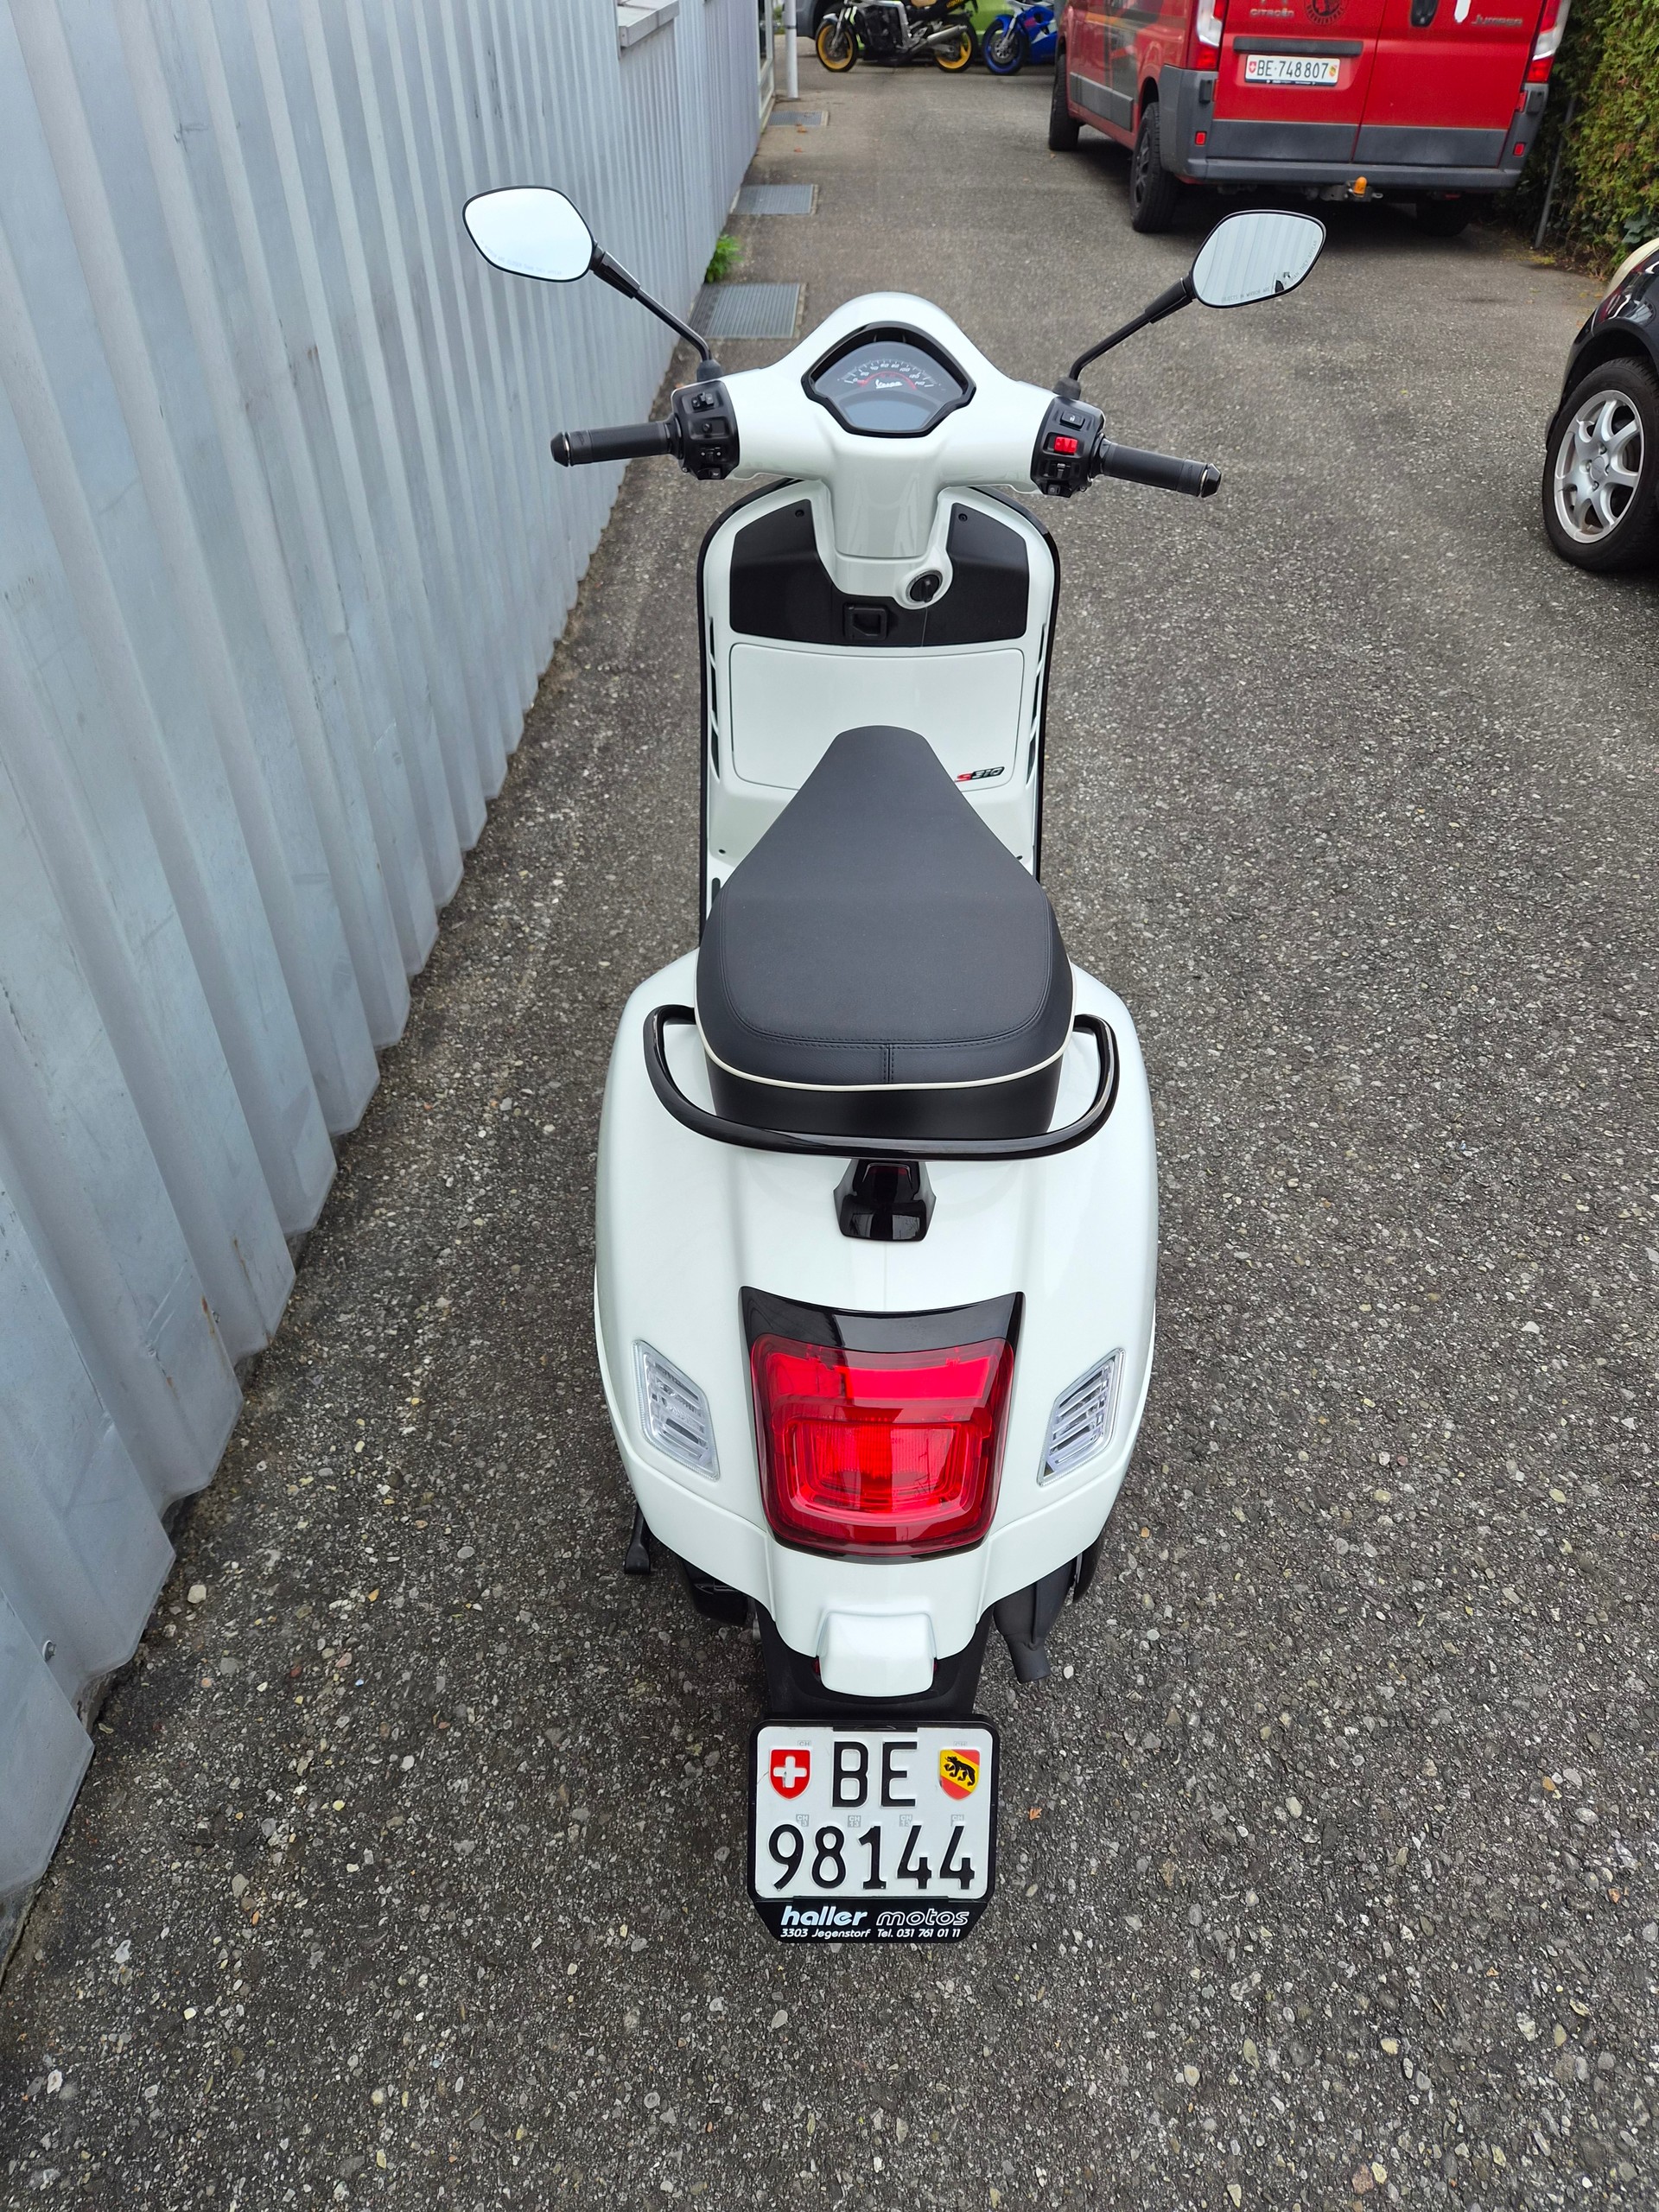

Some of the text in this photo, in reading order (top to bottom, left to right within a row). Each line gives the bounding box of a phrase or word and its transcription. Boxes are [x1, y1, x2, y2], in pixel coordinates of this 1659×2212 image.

[831, 1740, 918, 1808] BE
[768, 1824, 975, 1890] 98144
[780, 1905, 969, 1926] haller motos
[780, 1929, 961, 1940] 3303 Jegenstorf Tel. 031 761 01 11
